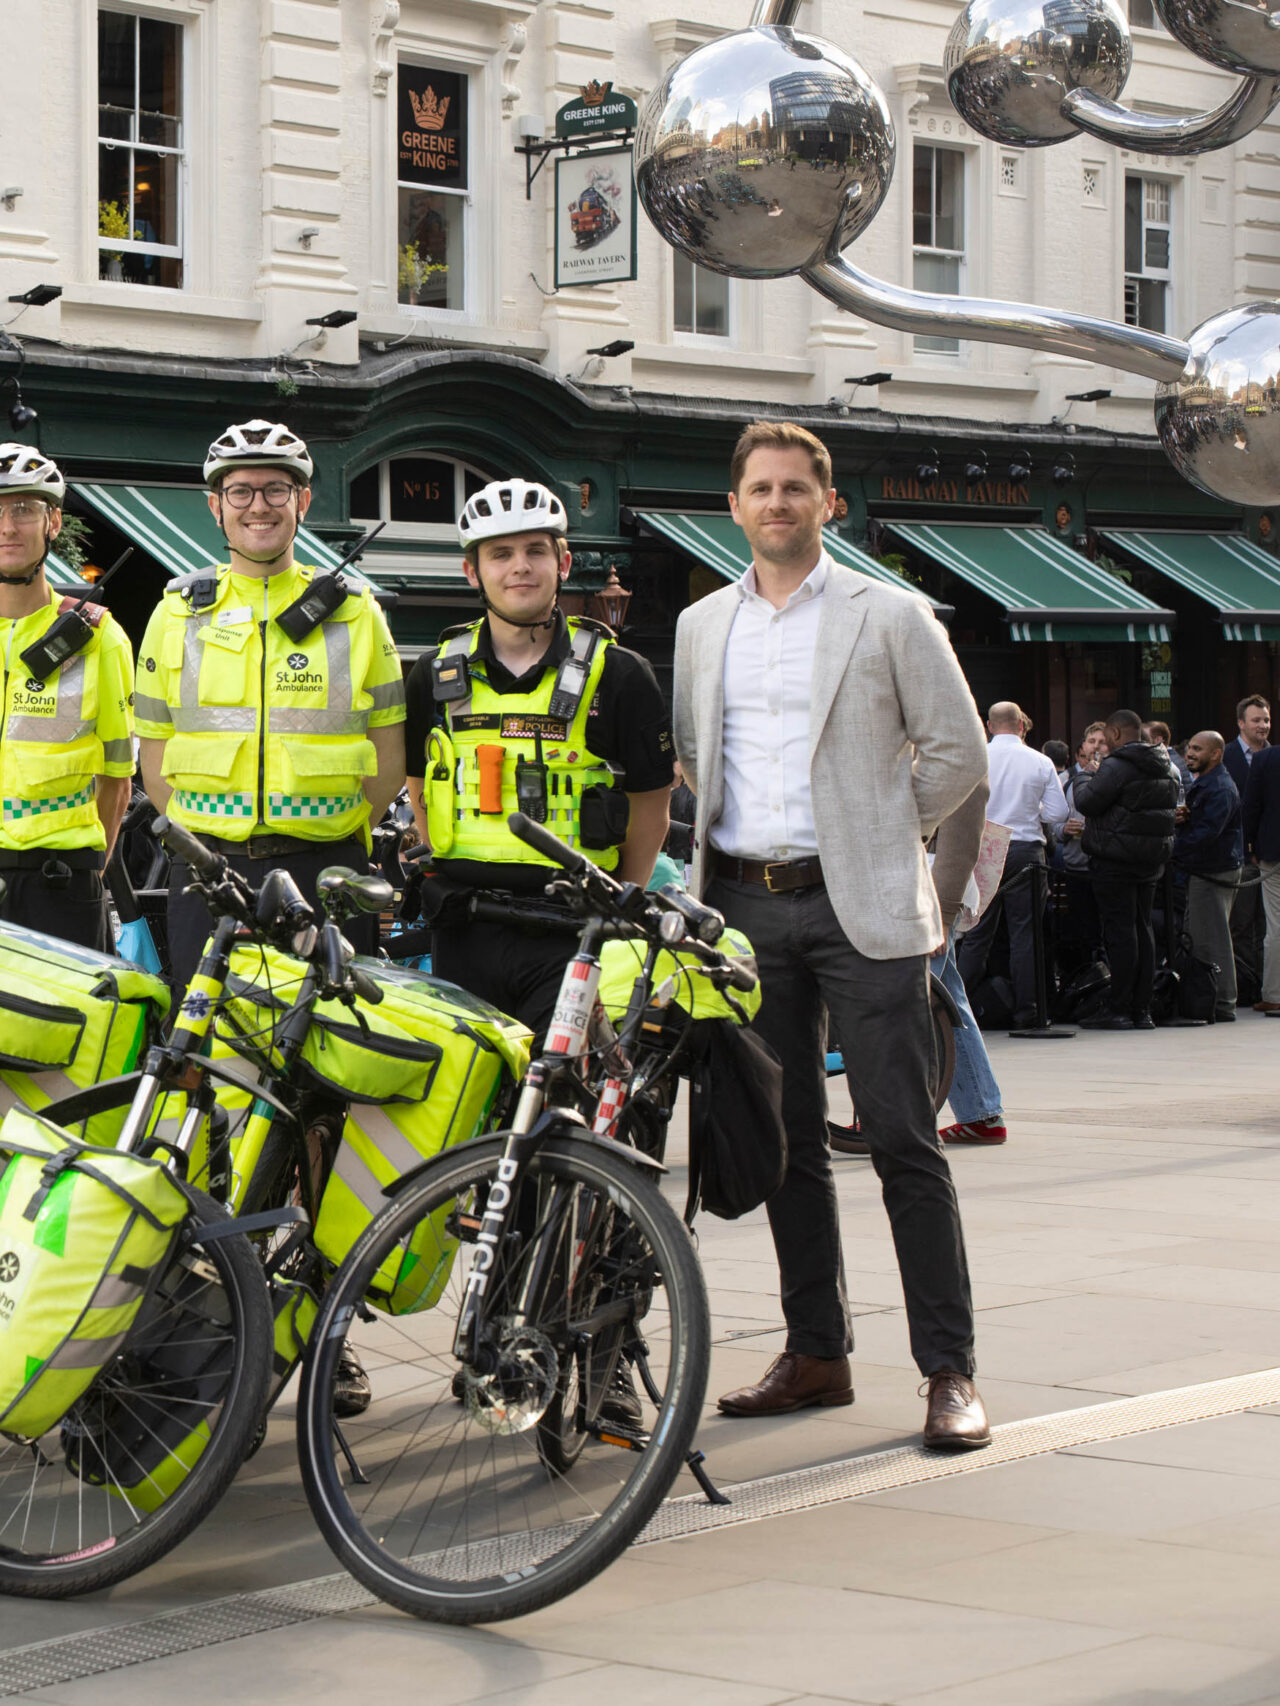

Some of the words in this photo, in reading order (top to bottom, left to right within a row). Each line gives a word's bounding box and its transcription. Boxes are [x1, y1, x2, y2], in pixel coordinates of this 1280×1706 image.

[564, 106, 601, 121] GREENE
[602, 103, 626, 116] KING
[402, 130, 456, 154] GREENE
[413, 150, 446, 170] KING
[563, 258, 595, 269] RAILWAY
[598, 254, 626, 265] TAVERN
[425, 481, 440, 500] 15
[215, 633, 230, 642] Unit
[276, 672, 288, 683] St
[292, 671, 322, 683] John
[276, 683, 323, 692] Ambulance
[13, 692, 24, 704] St
[25, 693, 55, 705] John
[12, 705, 55, 714] Ambulance
[525, 722, 566, 734] POLICE
[554, 1010, 588, 1030] OLICE
[468, 1158, 519, 1297] POLICE
